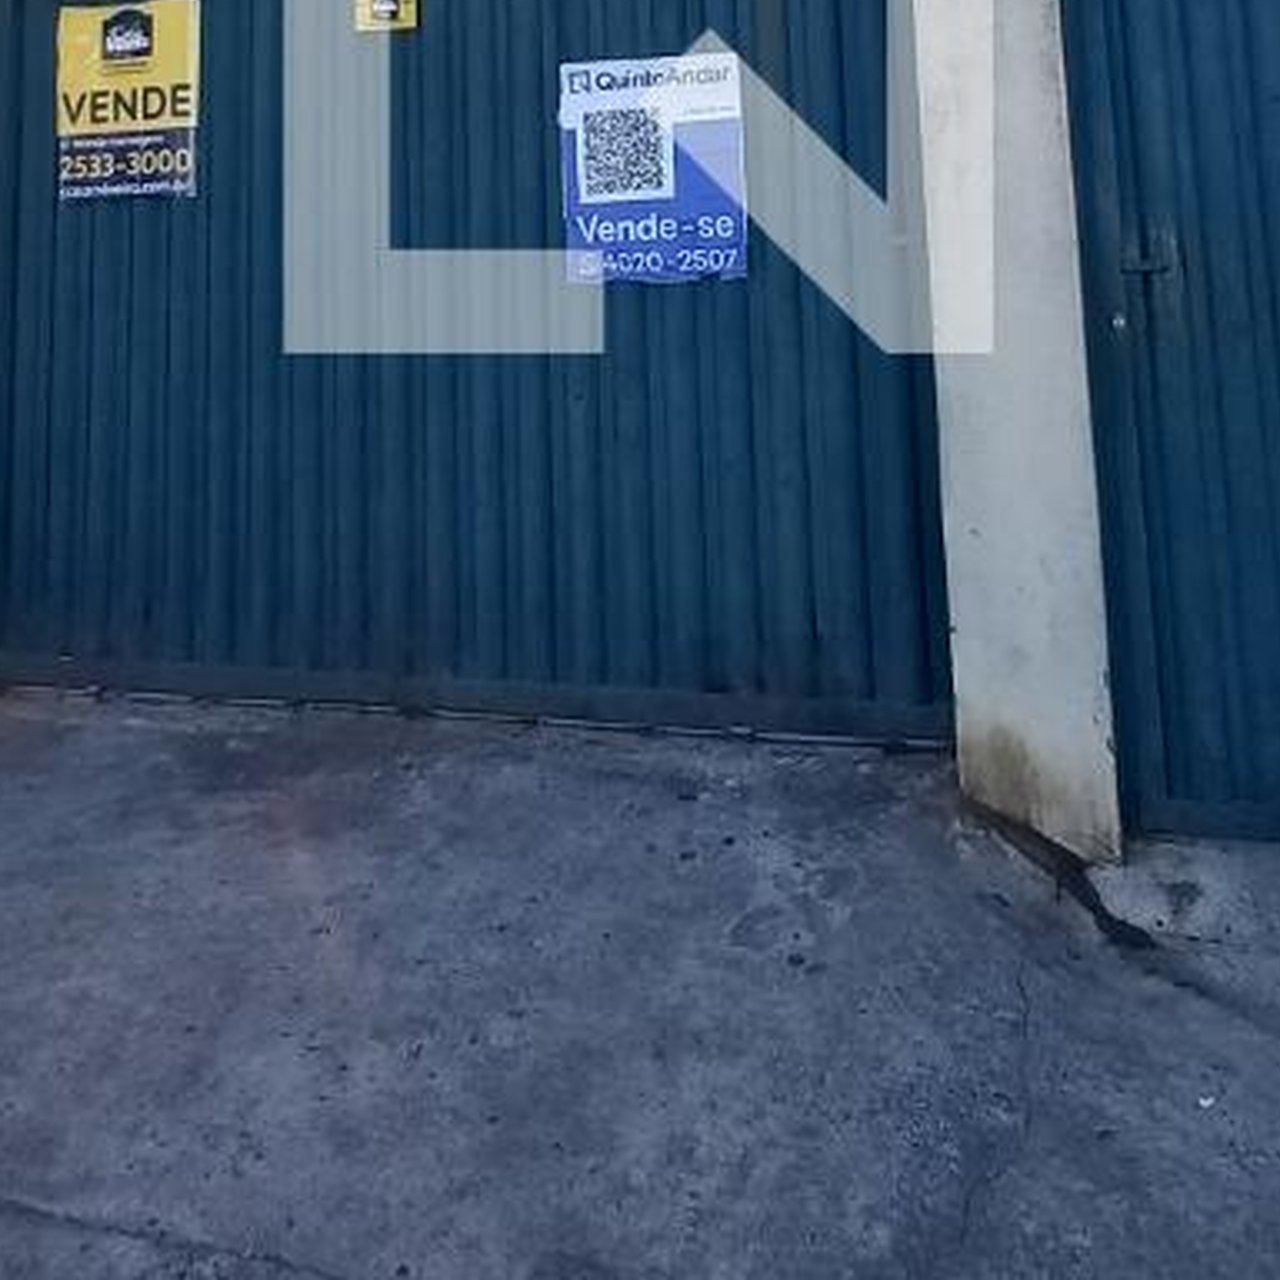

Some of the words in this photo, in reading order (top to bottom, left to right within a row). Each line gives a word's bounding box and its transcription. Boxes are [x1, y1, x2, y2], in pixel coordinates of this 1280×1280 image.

[62, 84, 193, 125] VENDE
[60, 148, 191, 179] 2533-3000
[576, 213, 735, 243] Vende-se
